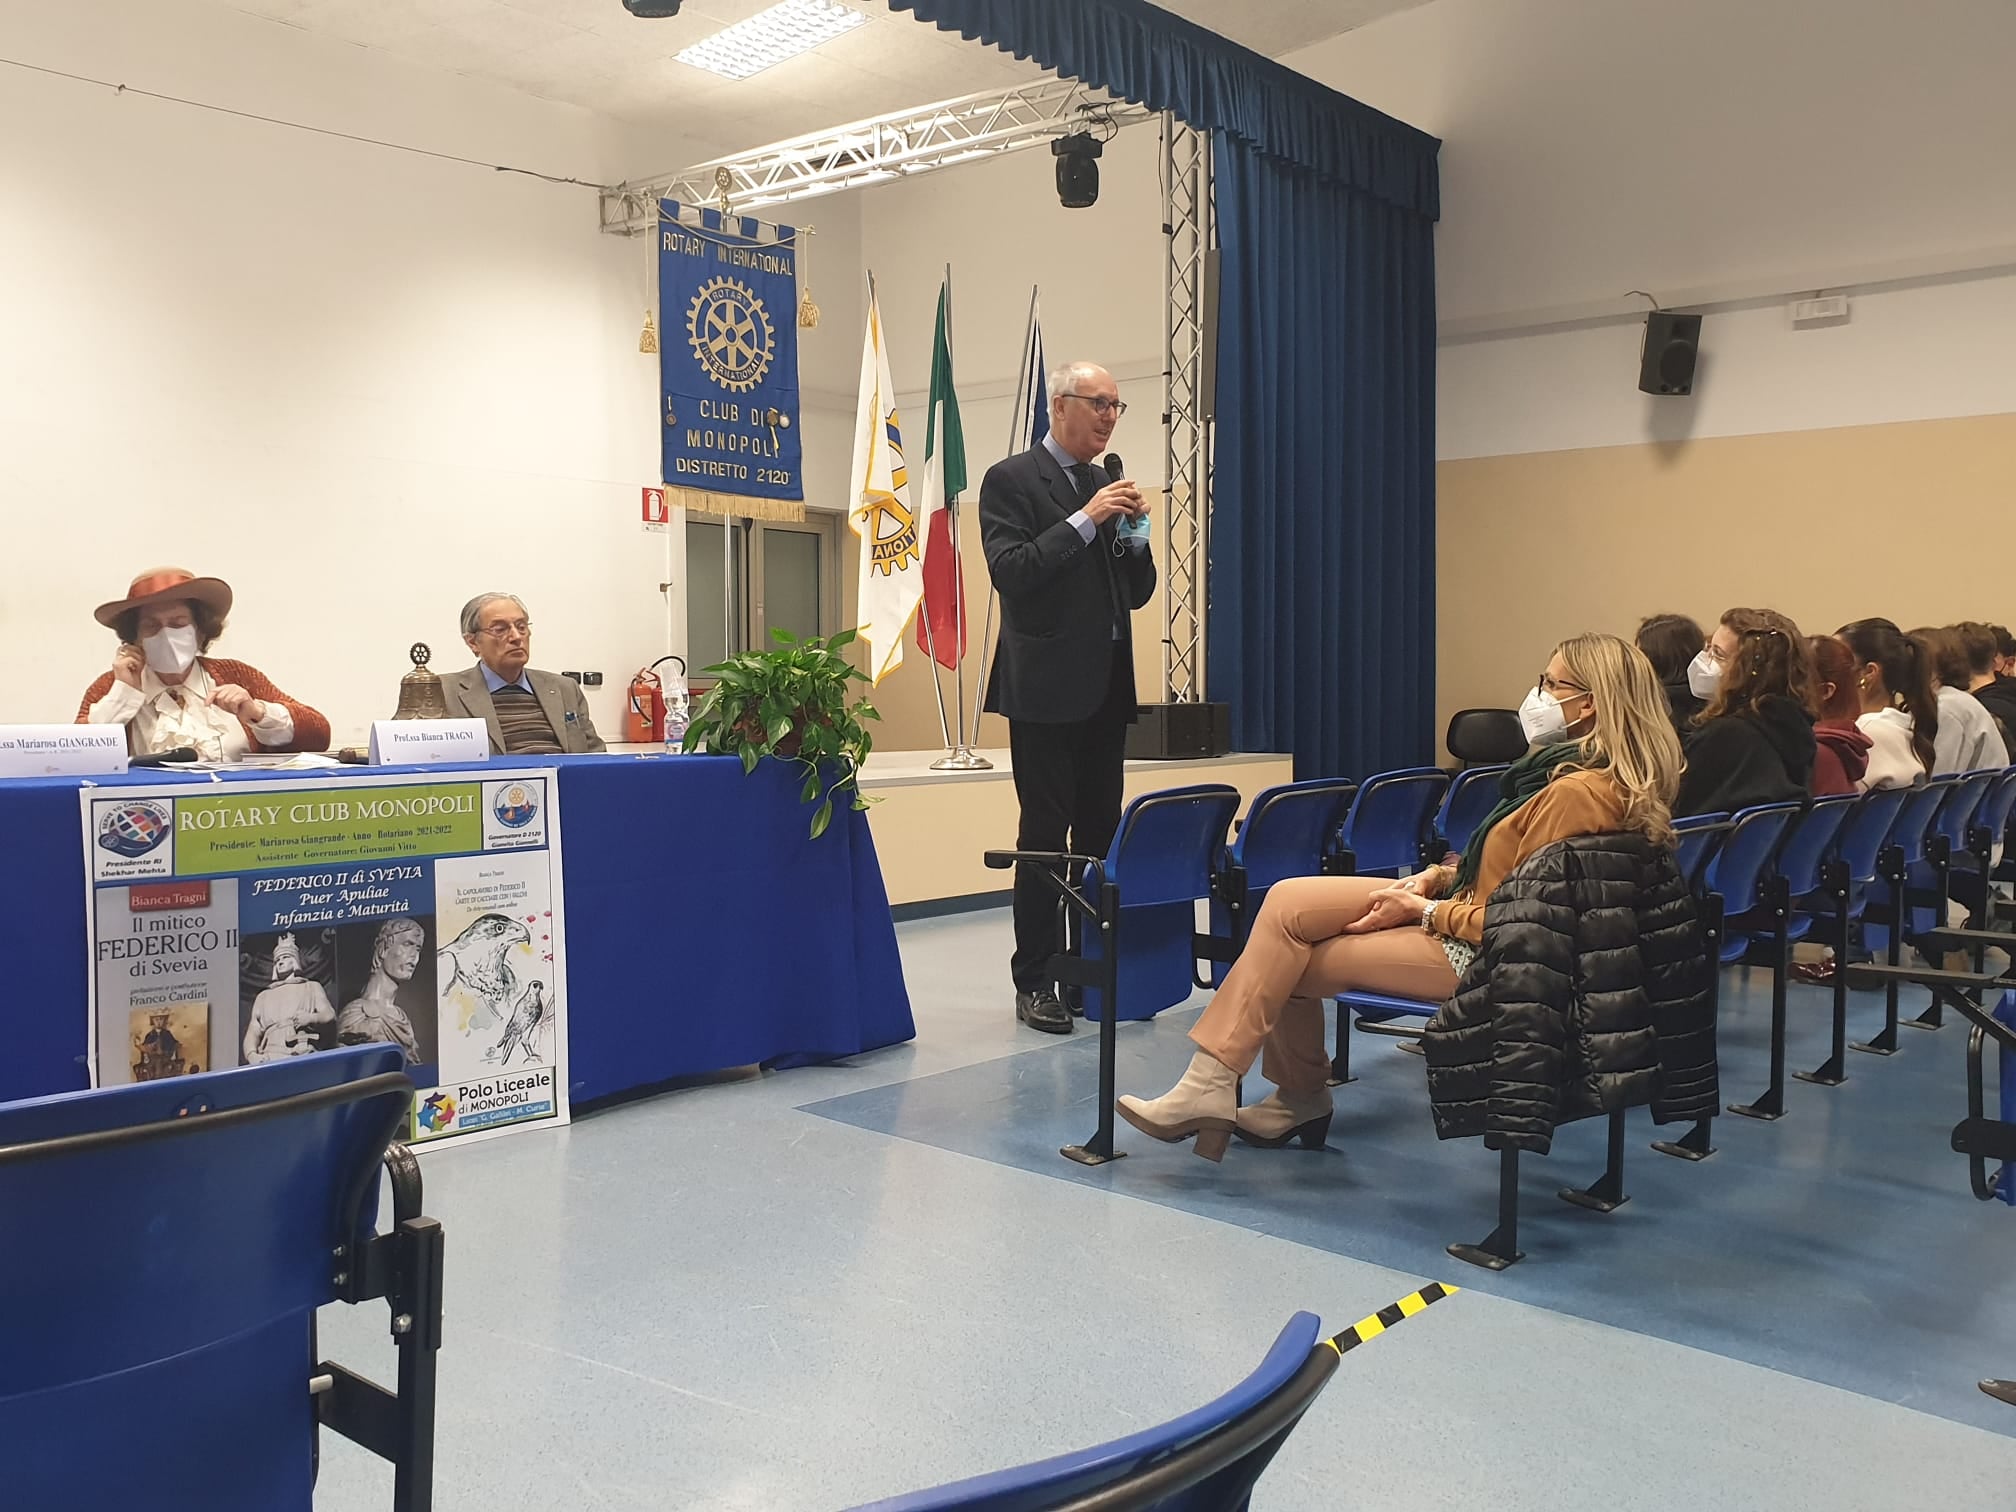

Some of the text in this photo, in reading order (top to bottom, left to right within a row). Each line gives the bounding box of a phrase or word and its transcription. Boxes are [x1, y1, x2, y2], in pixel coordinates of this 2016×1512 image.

[663, 231, 793, 276] ROTARY INTERNATIONAL
[712, 289, 750, 306] ROTARY
[701, 344, 761, 381] INTERNATIONAL
[700, 399, 764, 427] CLUB DI
[687, 428, 779, 459] MONOPOLI
[676, 457, 748, 480] DISTRETTO
[16, 738, 57, 749] Mariarosa
[58, 736, 118, 748] GIANGRANDE
[421, 733, 444, 741] Bianca
[444, 731, 474, 741] TRAGNI
[113, 805, 123, 813] TO
[180, 795, 475, 831] ROTARY CLUB MONOPOLI
[210, 840, 256, 852] Presidente:
[260, 836, 299, 849] Mariarosa
[301, 833, 346, 845] Giangrande
[352, 832, 373, 841] Anno
[378, 828, 414, 841] Rotariano
[417, 825, 452, 837] 2021-2022
[105, 859, 152, 868] Presidente
[256, 842, 417, 863] Assistente Governatore: Giovanni Vitto
[101, 867, 166, 878] Shekhar Mehta
[252, 866, 423, 896] FEDERICO II di SVEVIA
[131, 892, 206, 907] Bianca Tragni
[300, 885, 390, 906] Puer Apuliae
[133, 915, 206, 933] Il mitico
[272, 898, 410, 929] Infanzia e Maturità
[98, 928, 238, 961] FEDERICO II
[130, 956, 208, 977] di Svevia
[130, 988, 208, 1007] Franco Cardini
[459, 1073, 550, 1102] Polo Liceale
[458, 1092, 529, 1115] di MONOPOLI
